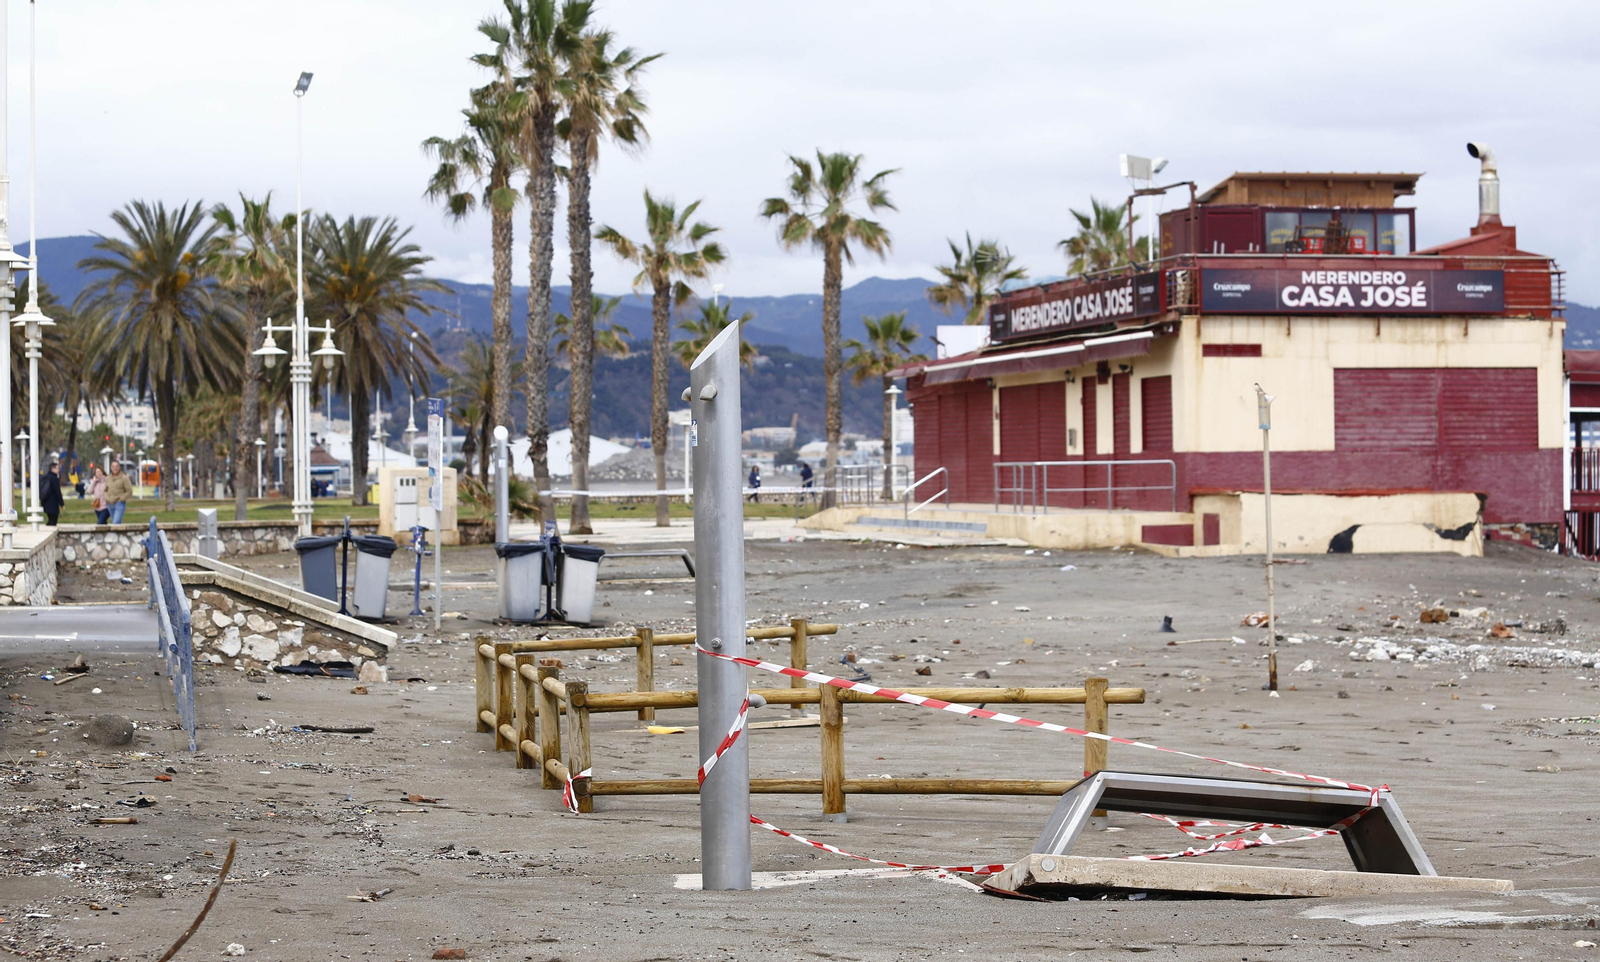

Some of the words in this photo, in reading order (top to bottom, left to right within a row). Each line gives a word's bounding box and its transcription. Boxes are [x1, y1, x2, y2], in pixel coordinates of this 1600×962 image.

[1301, 271, 1407, 285] MERENDERO
[1011, 299, 1072, 333] MERENDERO
[1073, 291, 1104, 322] CASA
[1104, 279, 1134, 317] JOSÉ
[1281, 286, 1355, 308] CASA
[1361, 280, 1427, 308] JOSÉ
